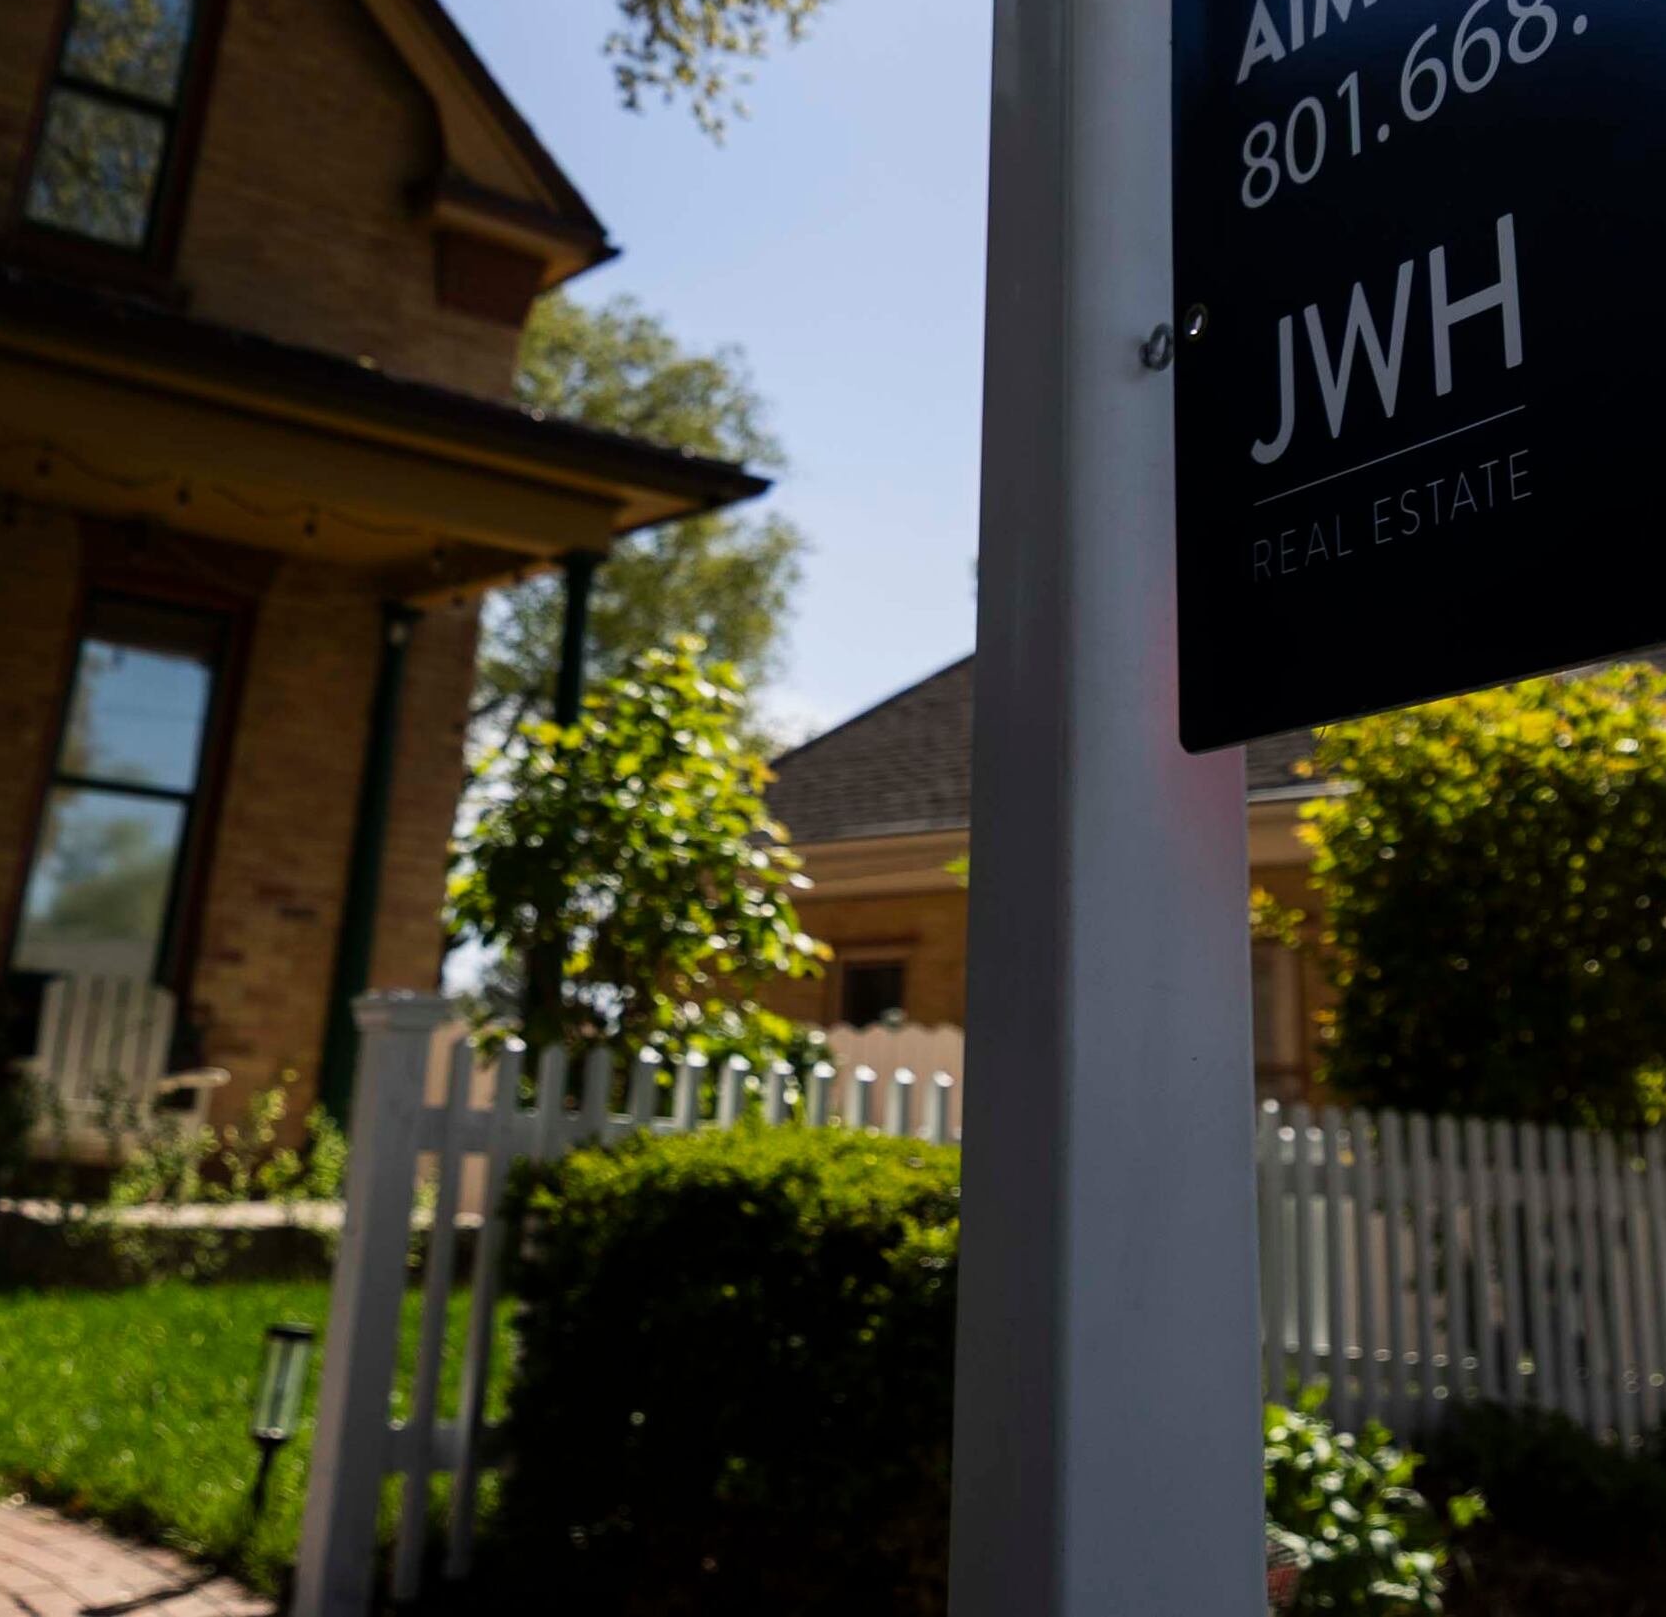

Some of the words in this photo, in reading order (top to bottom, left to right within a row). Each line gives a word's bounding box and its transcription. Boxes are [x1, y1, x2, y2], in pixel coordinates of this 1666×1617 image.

[1250, 212, 1524, 466] JWH
[1252, 514, 1354, 584] REAL
[1371, 449, 1533, 543] ESTATE
